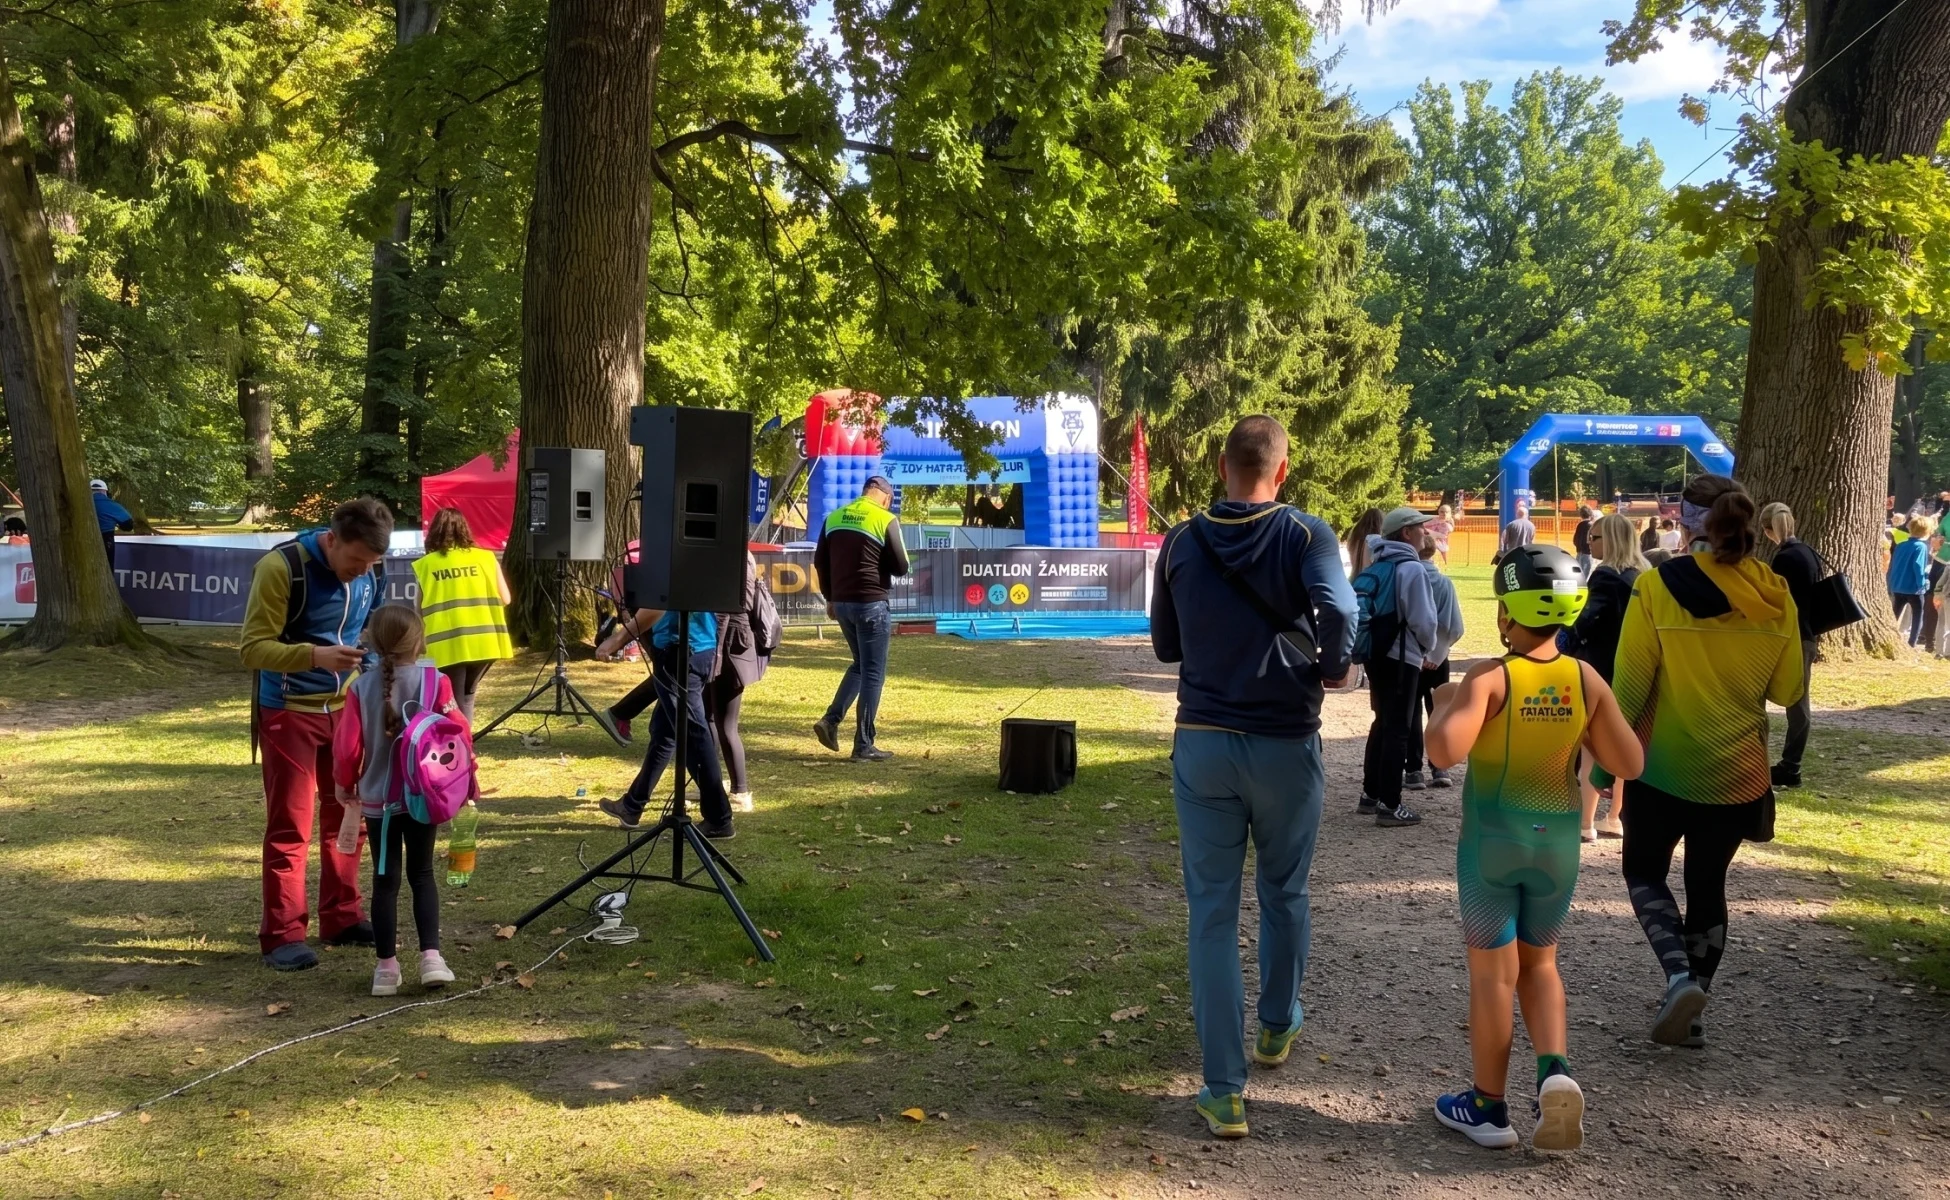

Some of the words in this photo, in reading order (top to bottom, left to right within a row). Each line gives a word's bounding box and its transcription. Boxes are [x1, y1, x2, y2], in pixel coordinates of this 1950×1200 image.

[962, 563, 1032, 577] DUATLON
[1037, 559, 1109, 577] ŽAMBERK
[114, 568, 240, 595] TRIATLON
